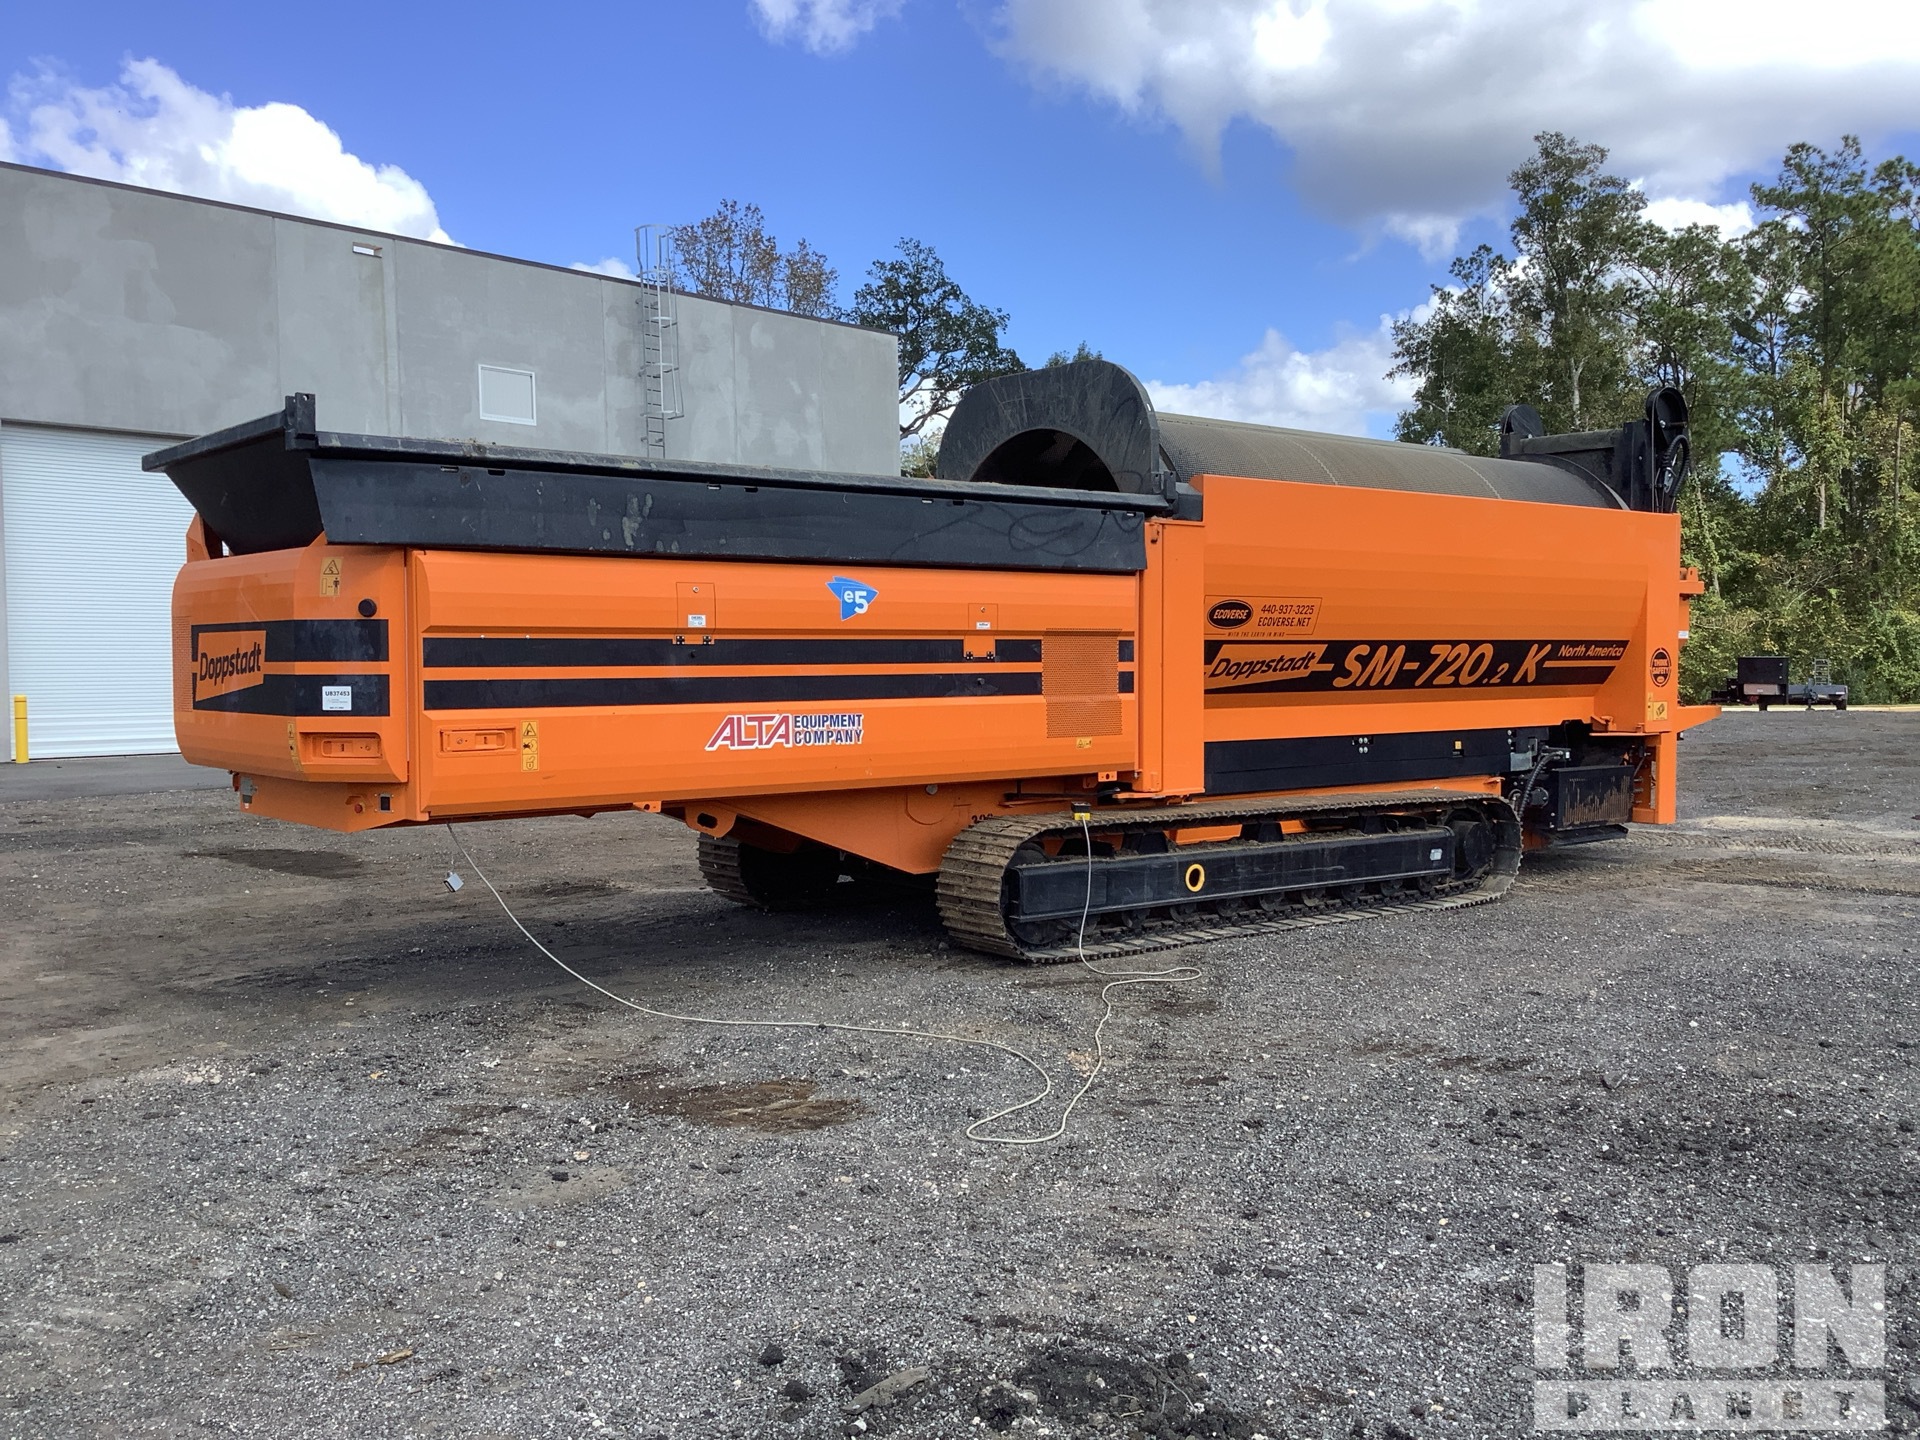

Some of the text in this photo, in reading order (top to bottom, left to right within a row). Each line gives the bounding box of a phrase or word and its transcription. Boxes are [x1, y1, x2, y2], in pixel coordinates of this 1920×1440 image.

[844, 590, 868, 613] e5
[1213, 609, 1249, 620] ECOVERSE
[1260, 604, 1315, 615] 440-937-3225
[1257, 617, 1312, 627] ECOVERSE.NET
[1558, 644, 1624, 657] North America
[199, 642, 262, 686] Doppstadt
[1208, 651, 1317, 680] Doppstadt
[1512, 643, 1552, 683] K
[1653, 659, 1668, 667] THINK
[1652, 666, 1669, 675] SAFETY
[706, 715, 863, 749] ALTA EQUIPMENT
[794, 730, 863, 745] COMPANY
